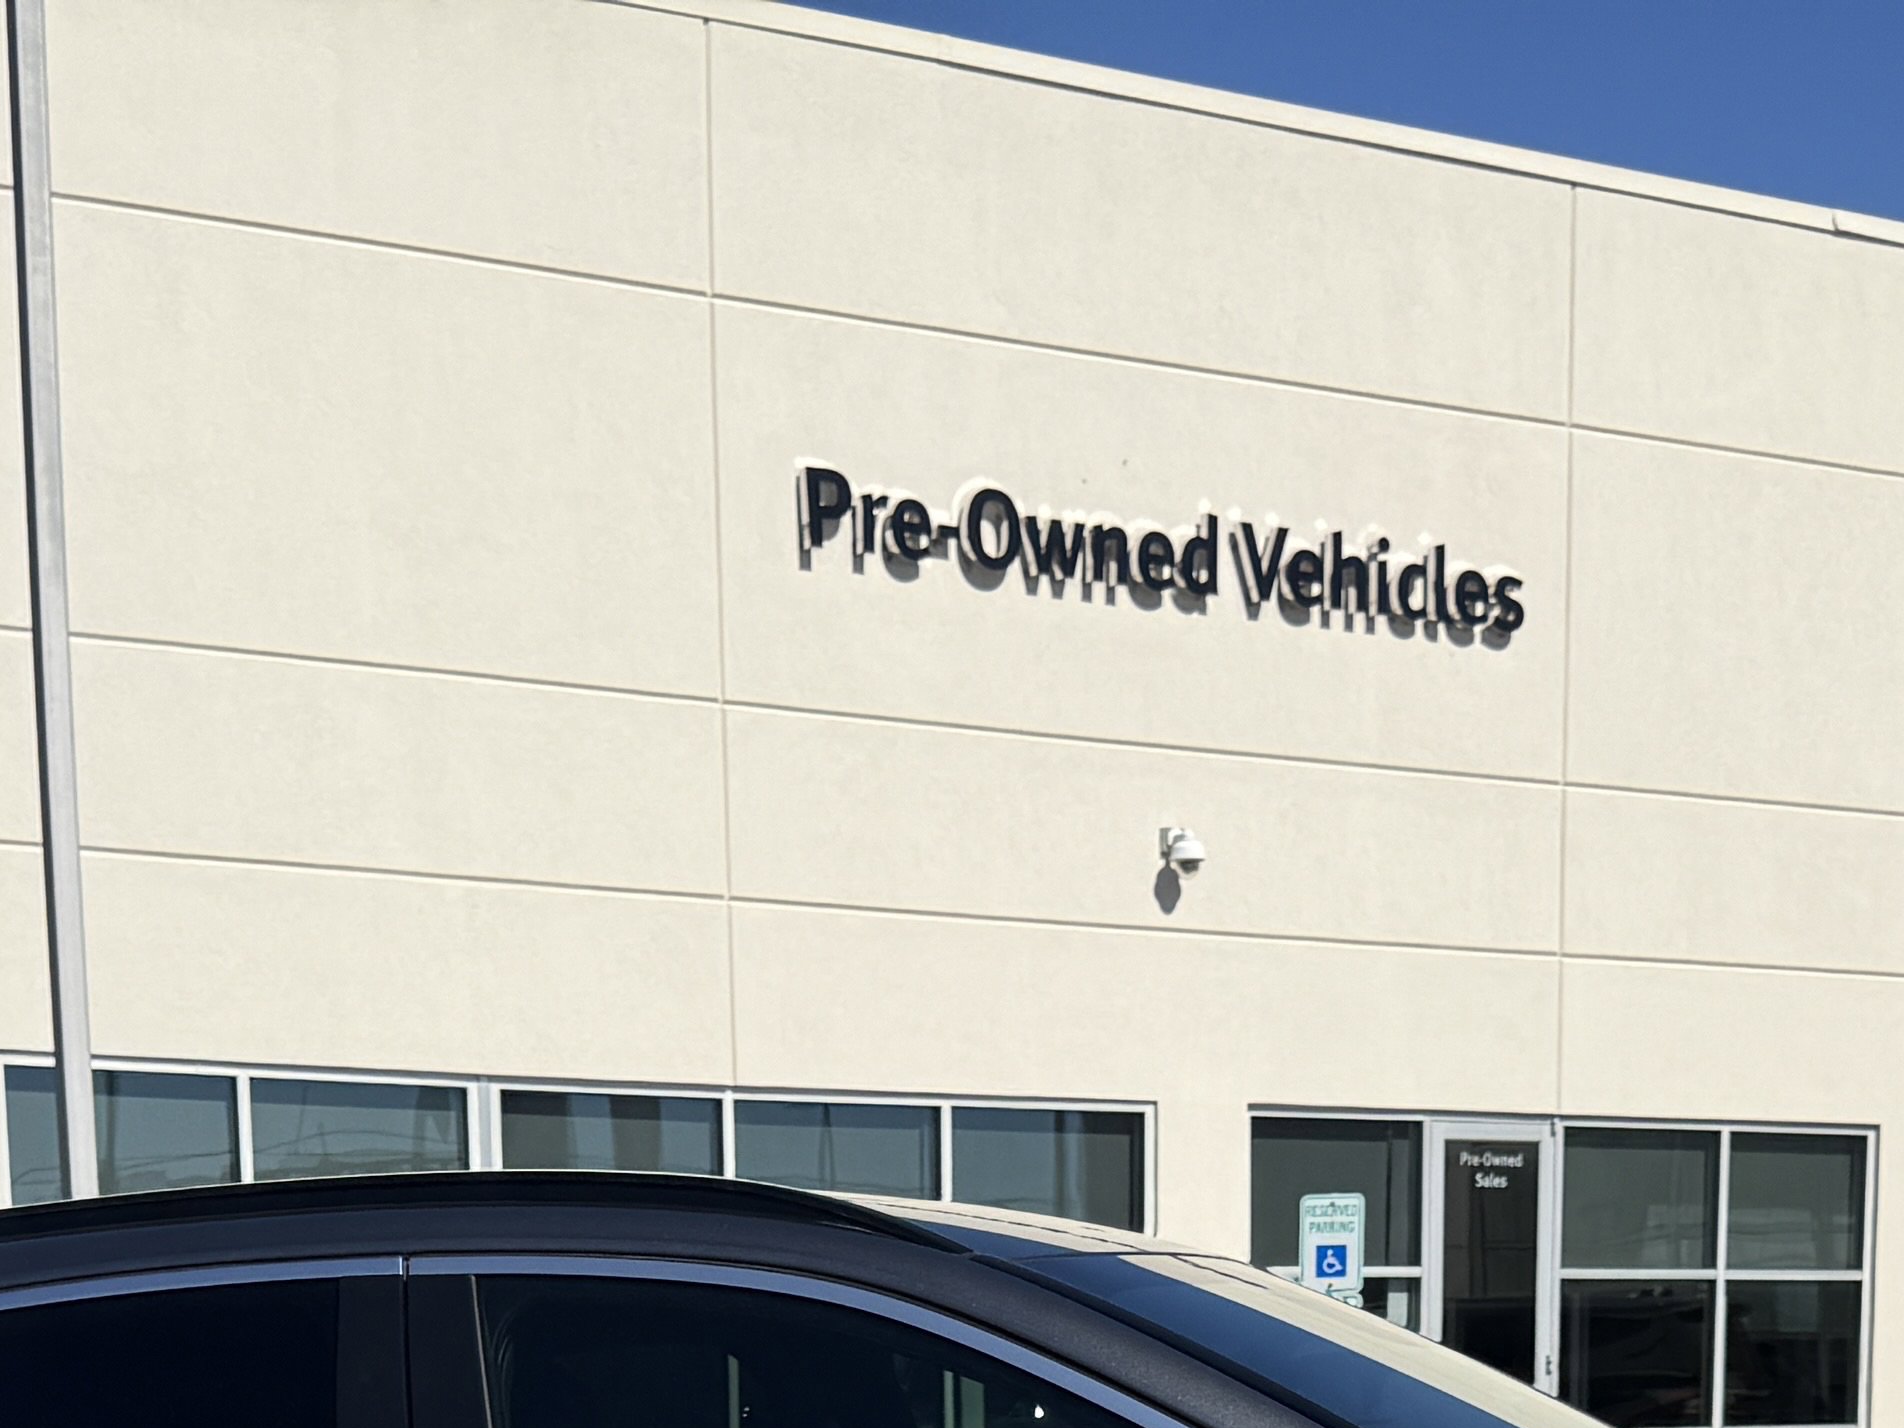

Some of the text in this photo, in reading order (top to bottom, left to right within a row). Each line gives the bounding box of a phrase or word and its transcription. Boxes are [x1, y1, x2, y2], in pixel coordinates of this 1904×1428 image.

[798, 464, 1525, 634] Pre-Owned Vehicles
[1459, 1151, 1524, 1168] Pre-Owned
[1474, 1172, 1508, 1189] Sales
[1304, 1204, 1357, 1217] RESERVED
[1309, 1221, 1355, 1234] PARKING
